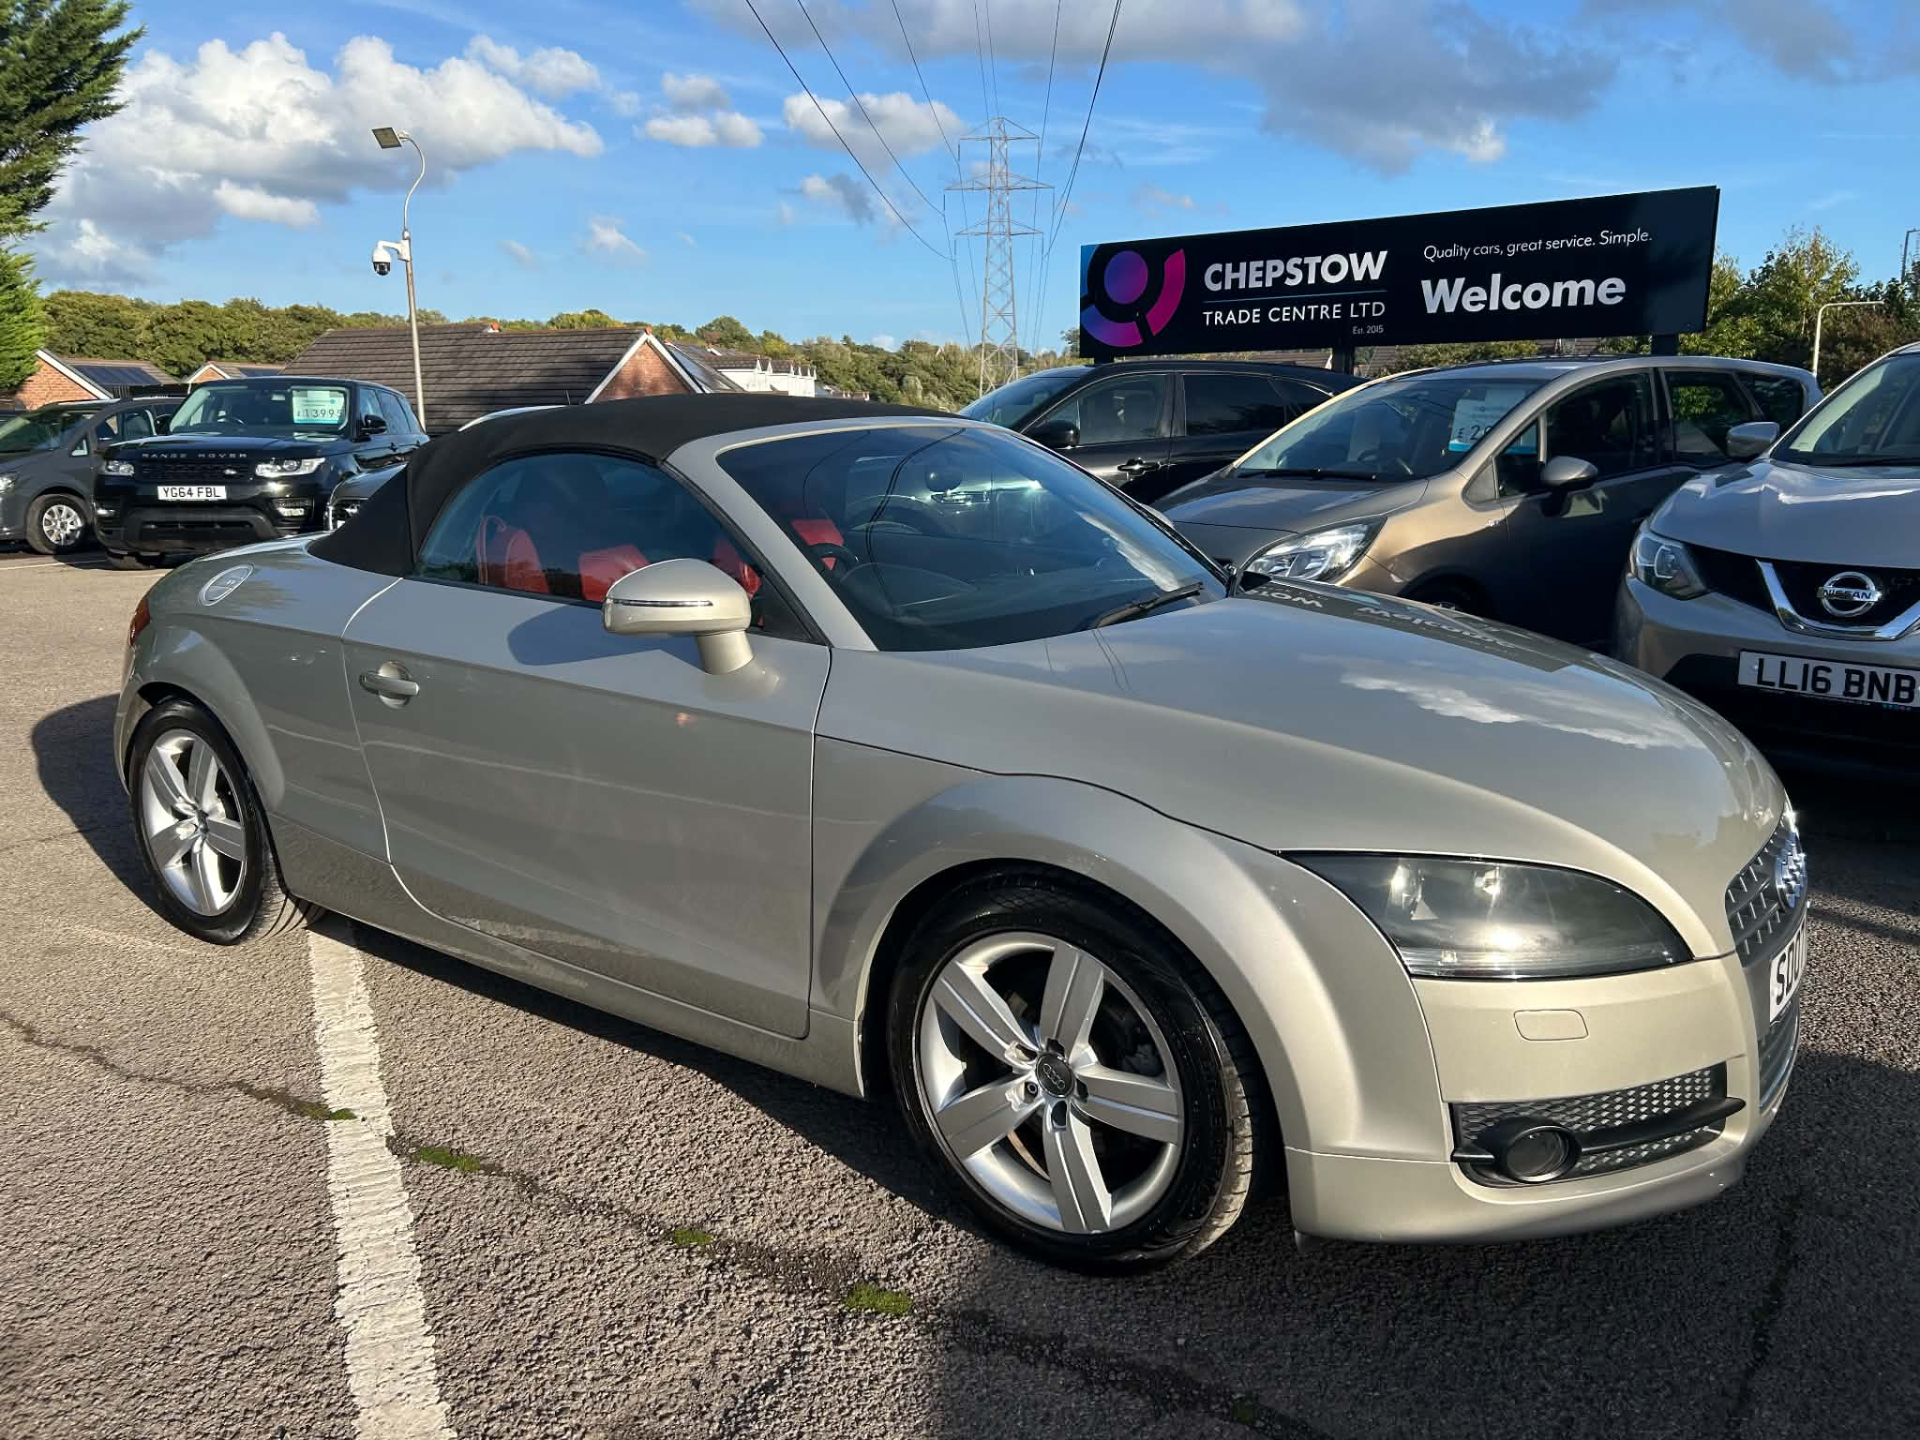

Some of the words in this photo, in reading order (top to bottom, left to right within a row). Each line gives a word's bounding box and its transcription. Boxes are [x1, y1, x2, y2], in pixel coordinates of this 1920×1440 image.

[1423, 243, 1470, 262] Quality
[1473, 242, 1504, 256] cars,
[1506, 239, 1543, 256] great
[1545, 234, 1596, 249] service.
[1599, 228, 1653, 246] Simple.
[1204, 251, 1388, 291] CHEPSTOW
[1421, 273, 1626, 314] Welcome
[1202, 308, 1261, 326] TRADE
[1268, 304, 1342, 322] CENTRE
[1350, 302, 1385, 318] LTD
[1352, 326, 1364, 335] Est.
[1366, 325, 1384, 334] 2015
[163, 487, 194, 497] YG64
[197, 487, 222, 497] FBL
[1823, 588, 1872, 600] NISSAN
[1757, 658, 1832, 694] LL16
[1843, 668, 1916, 704] BNB
